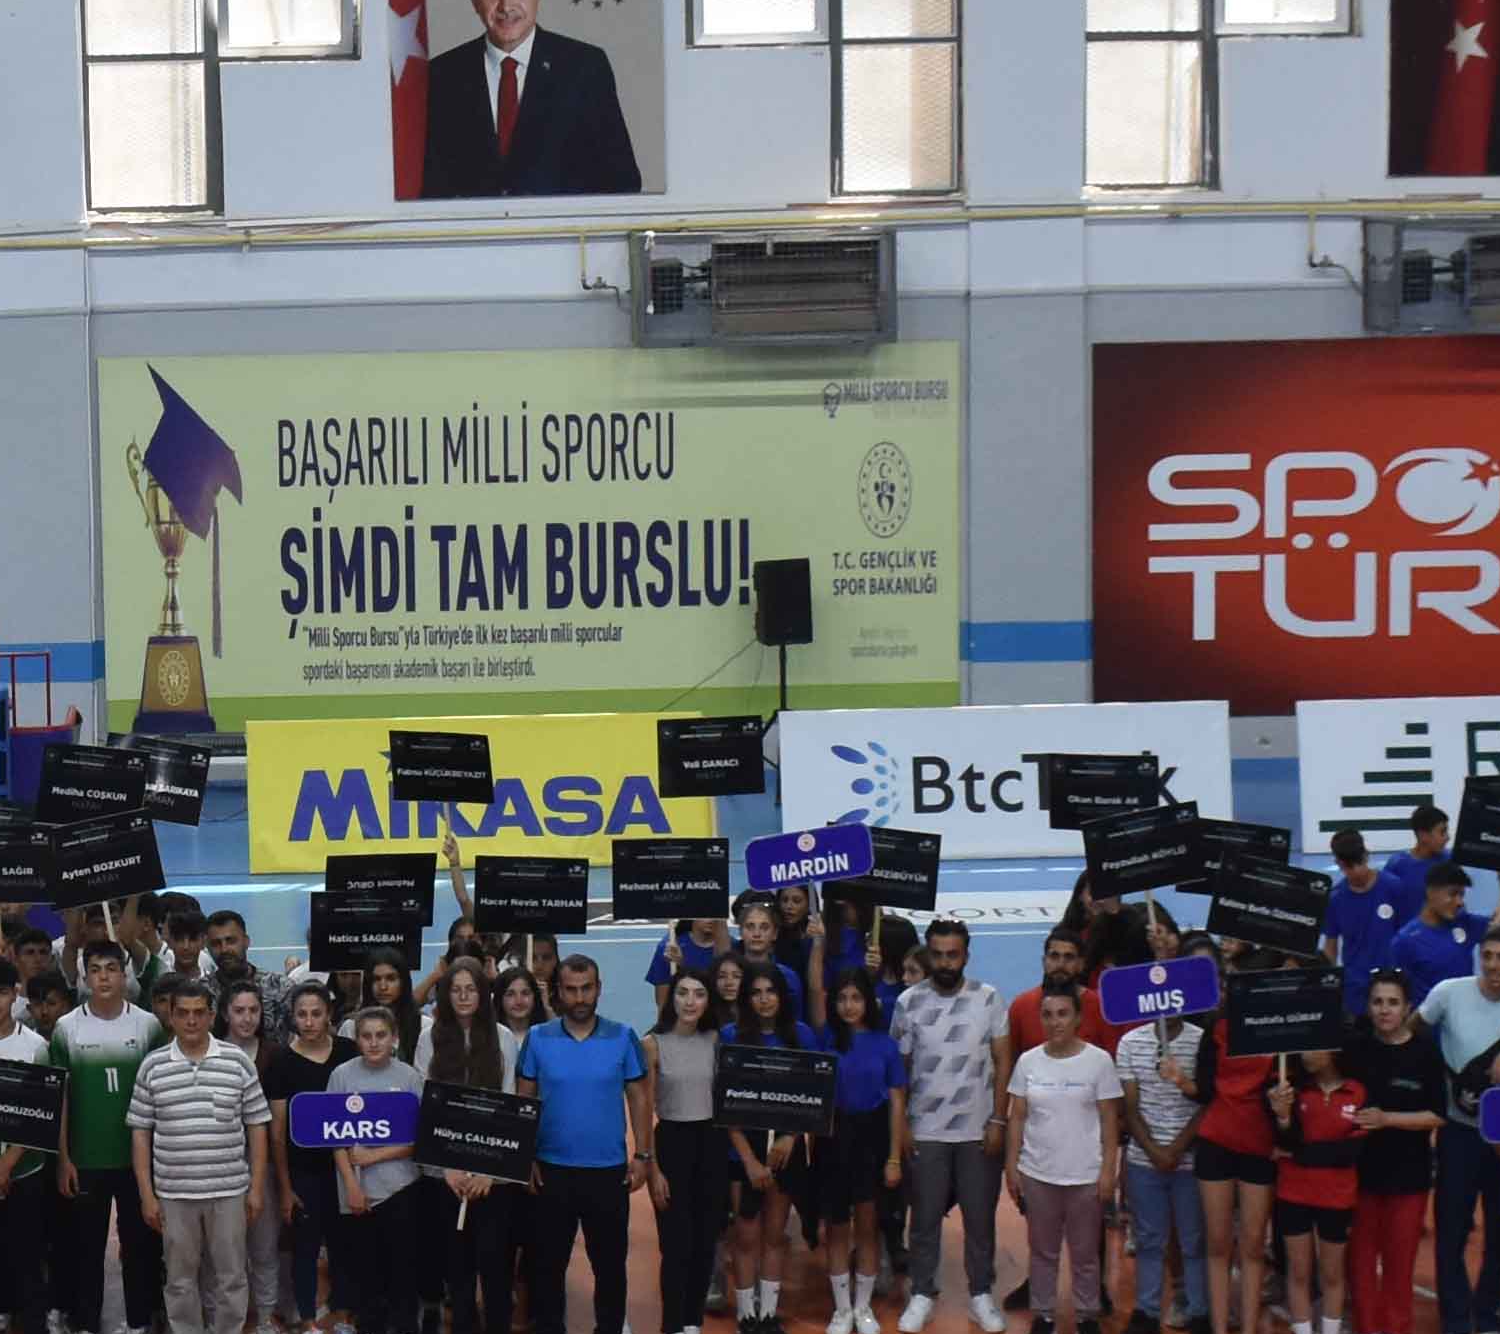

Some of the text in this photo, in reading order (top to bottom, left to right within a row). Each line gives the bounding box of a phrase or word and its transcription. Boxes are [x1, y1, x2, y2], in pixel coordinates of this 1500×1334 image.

[277, 400, 675, 503] BAŞARILI MİLLİ SPORCU
[281, 506, 752, 638] ŞİMDİ TAM BURSLU!
[833, 547, 937, 572] T.C. GENÇLİK VE
[833, 573, 937, 596] SPOR BAKANLIĞI
[62, 855, 141, 881] Ayten BOZKURT
[770, 850, 849, 883] MARDİN
[1138, 989, 1185, 1015] MUŞ
[105, 1066, 119, 1093] 11
[726, 1087, 759, 1100] Feride
[322, 1119, 391, 1140] KARS
[433, 1125, 463, 1142] Hülya
